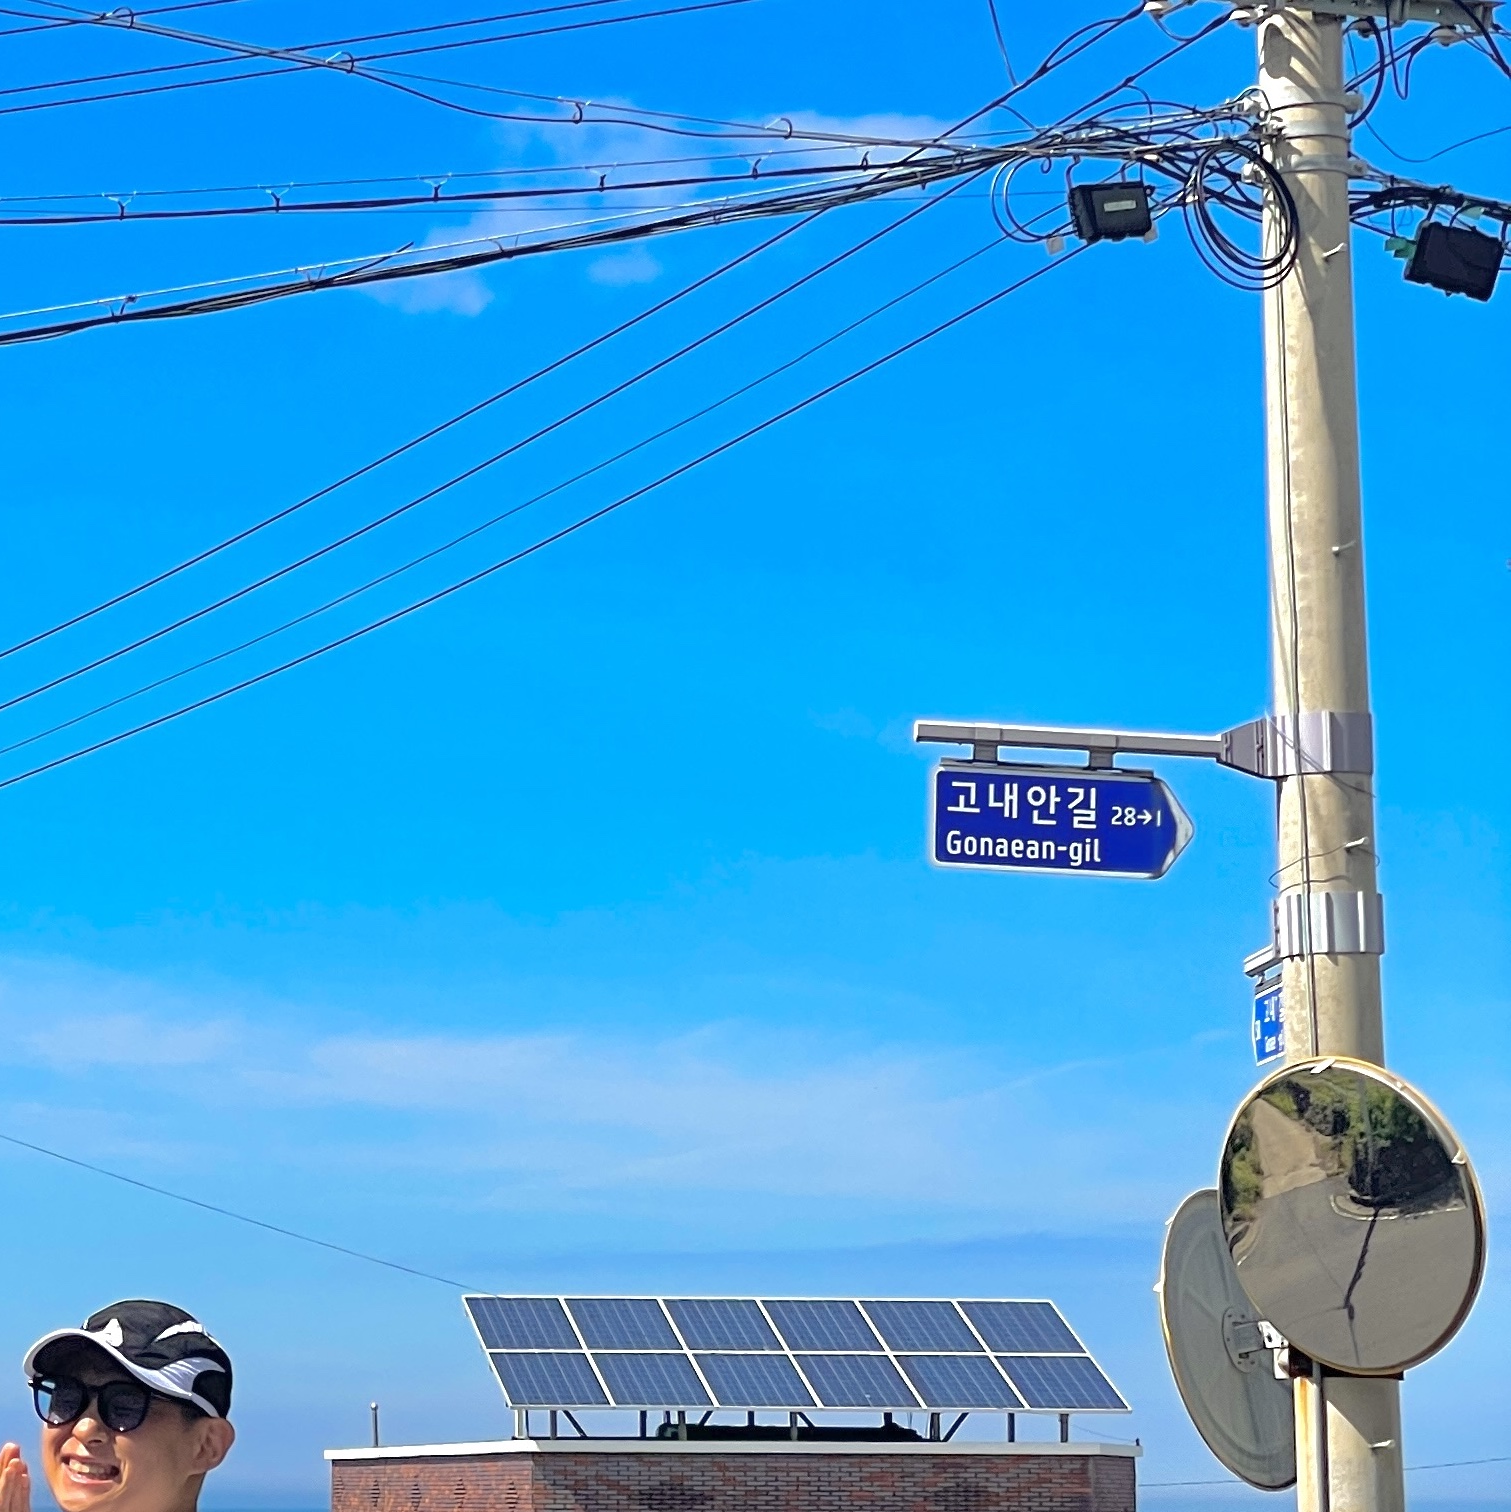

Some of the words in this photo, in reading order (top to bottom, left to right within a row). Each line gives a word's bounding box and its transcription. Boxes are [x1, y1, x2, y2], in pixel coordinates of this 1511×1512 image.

[946, 781, 1097, 829] 고내안길
[1110, 805, 1137, 827] 28
[946, 829, 1101, 866] Gonaean-gil
